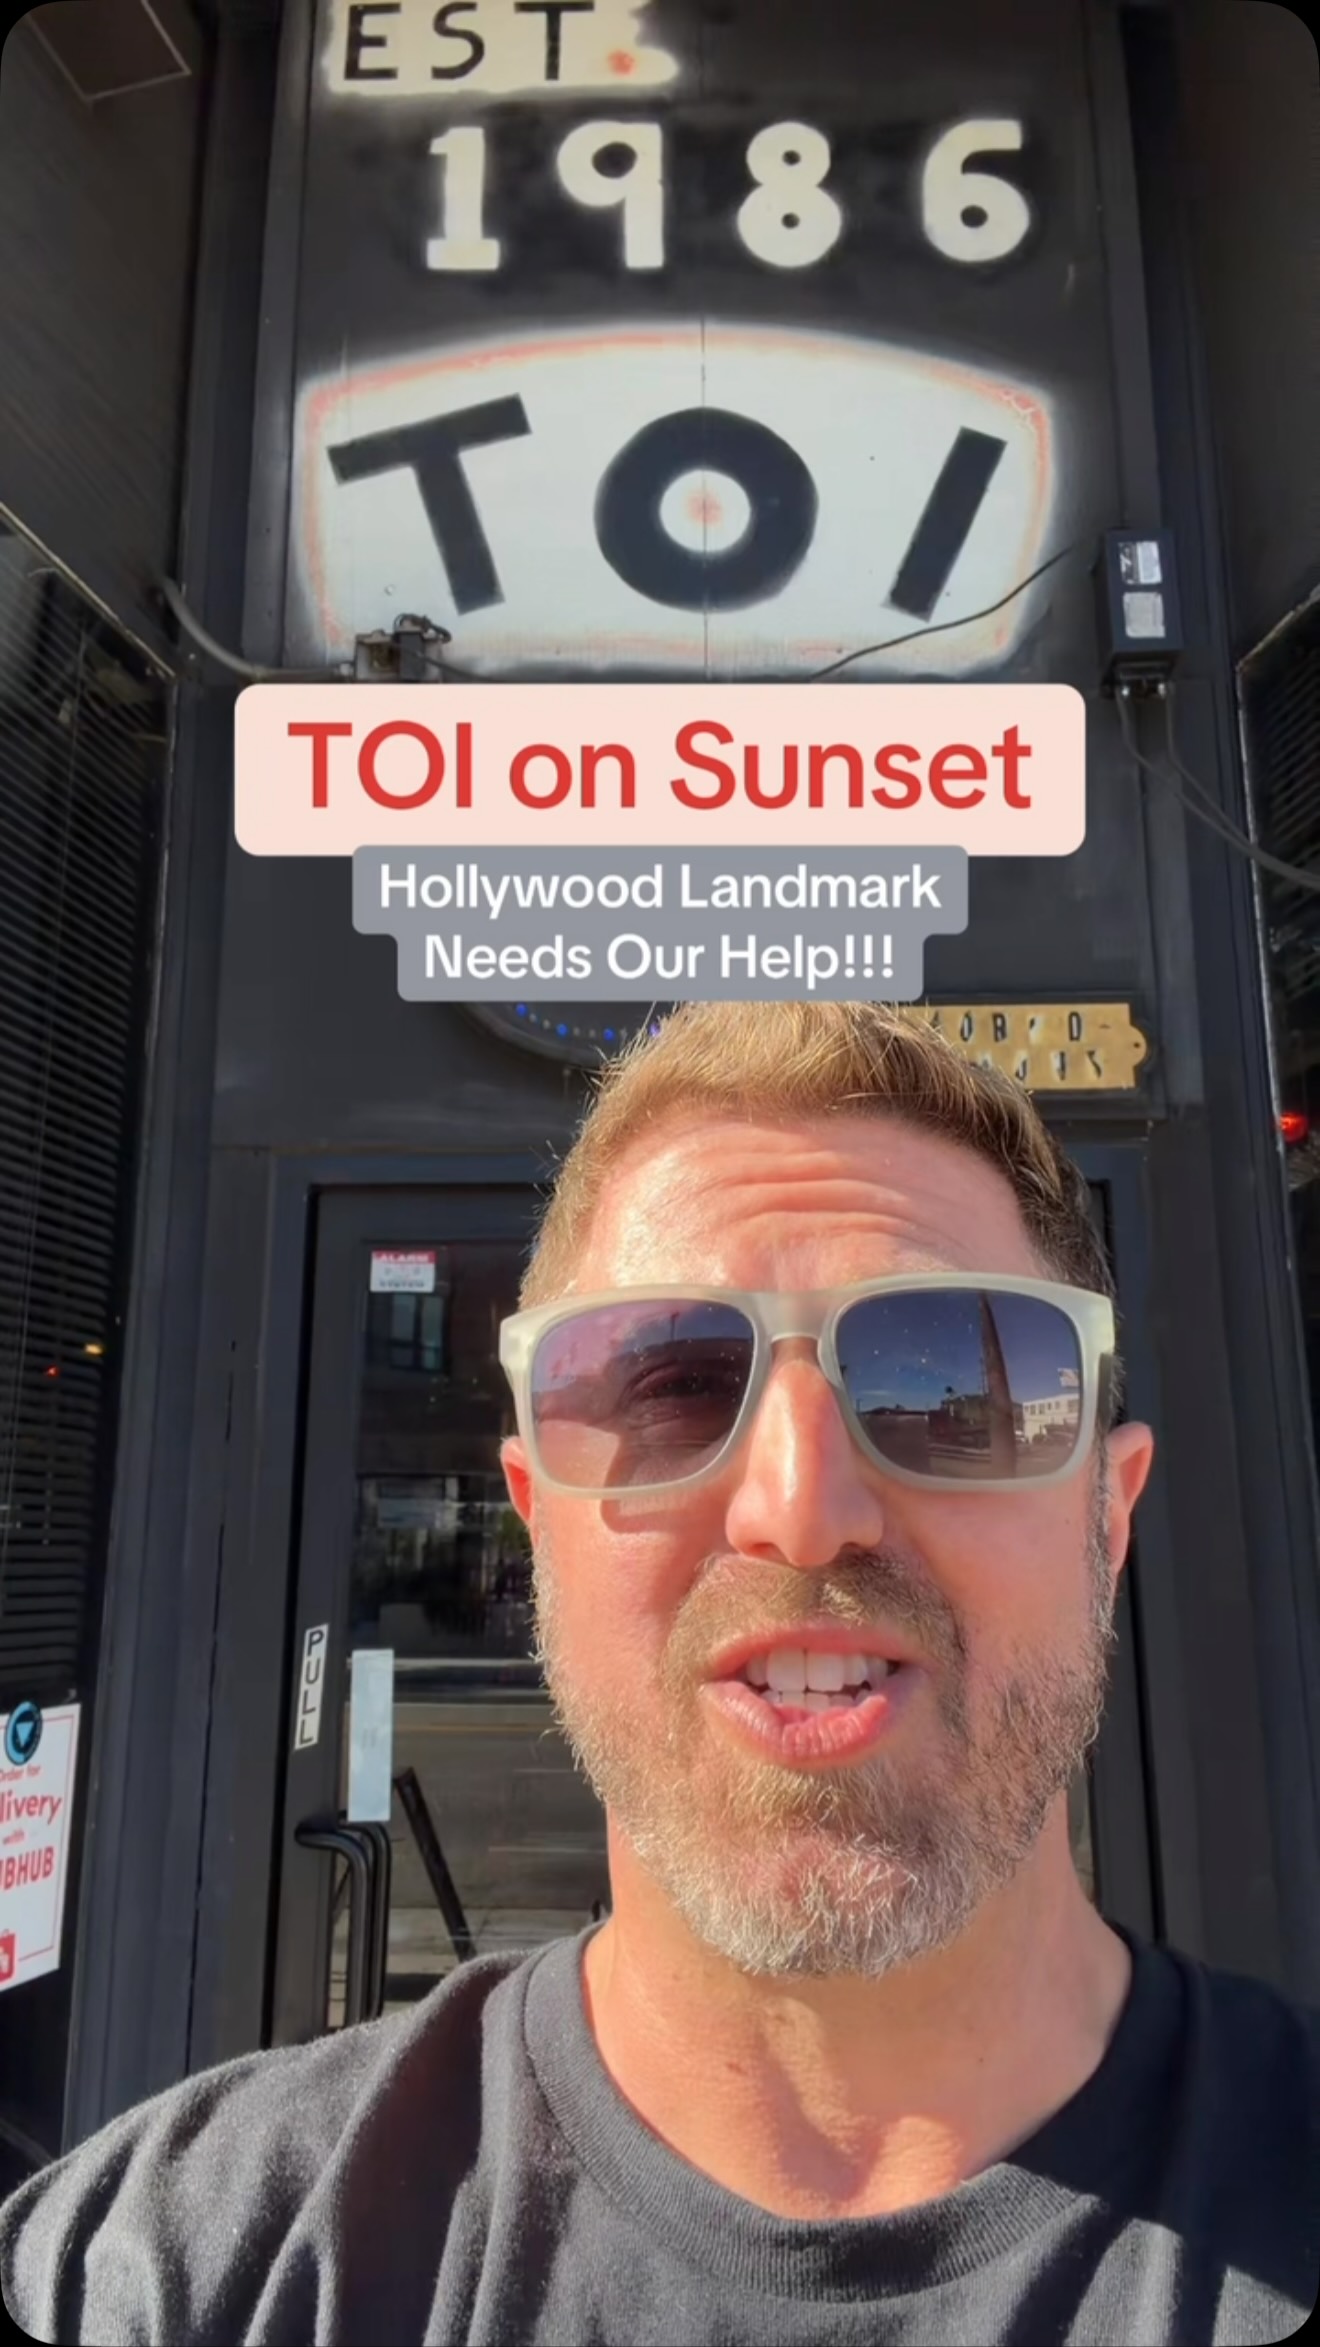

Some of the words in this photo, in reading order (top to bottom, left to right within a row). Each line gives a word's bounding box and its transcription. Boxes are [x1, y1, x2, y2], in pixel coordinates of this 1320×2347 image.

[426, 118, 1030, 270] 1986
[327, 393, 1007, 623] TOI
[300, 1629, 324, 1746] PULL
